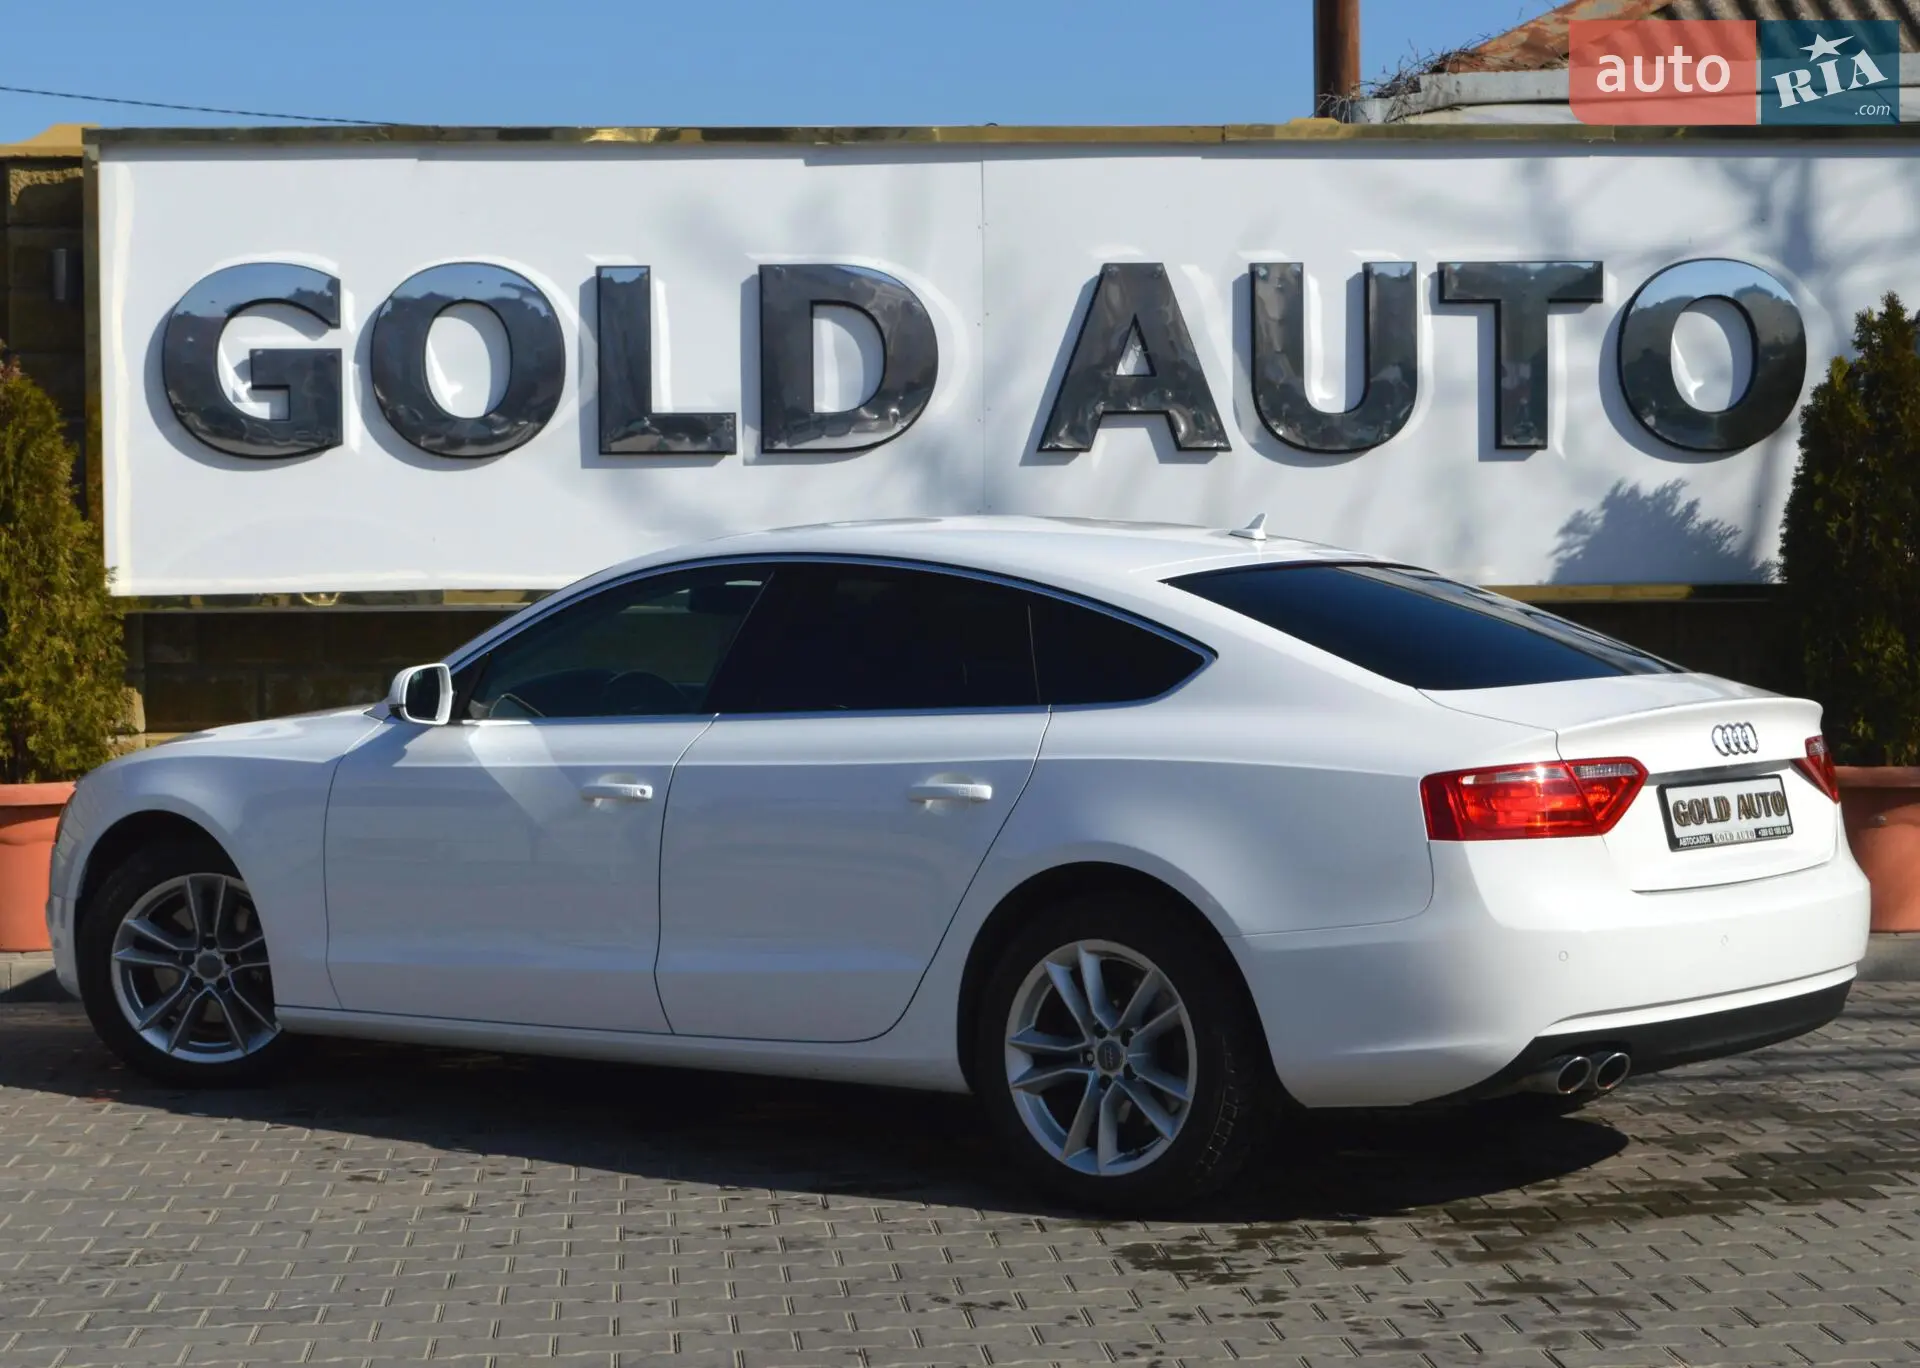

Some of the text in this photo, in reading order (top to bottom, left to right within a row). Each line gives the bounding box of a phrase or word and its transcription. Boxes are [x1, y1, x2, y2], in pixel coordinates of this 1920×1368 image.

[162, 257, 1809, 460] GOLD AUTO
[1672, 790, 1787, 827] GOLD AUTO
[1714, 830, 1755, 843] GOLD AUTO
